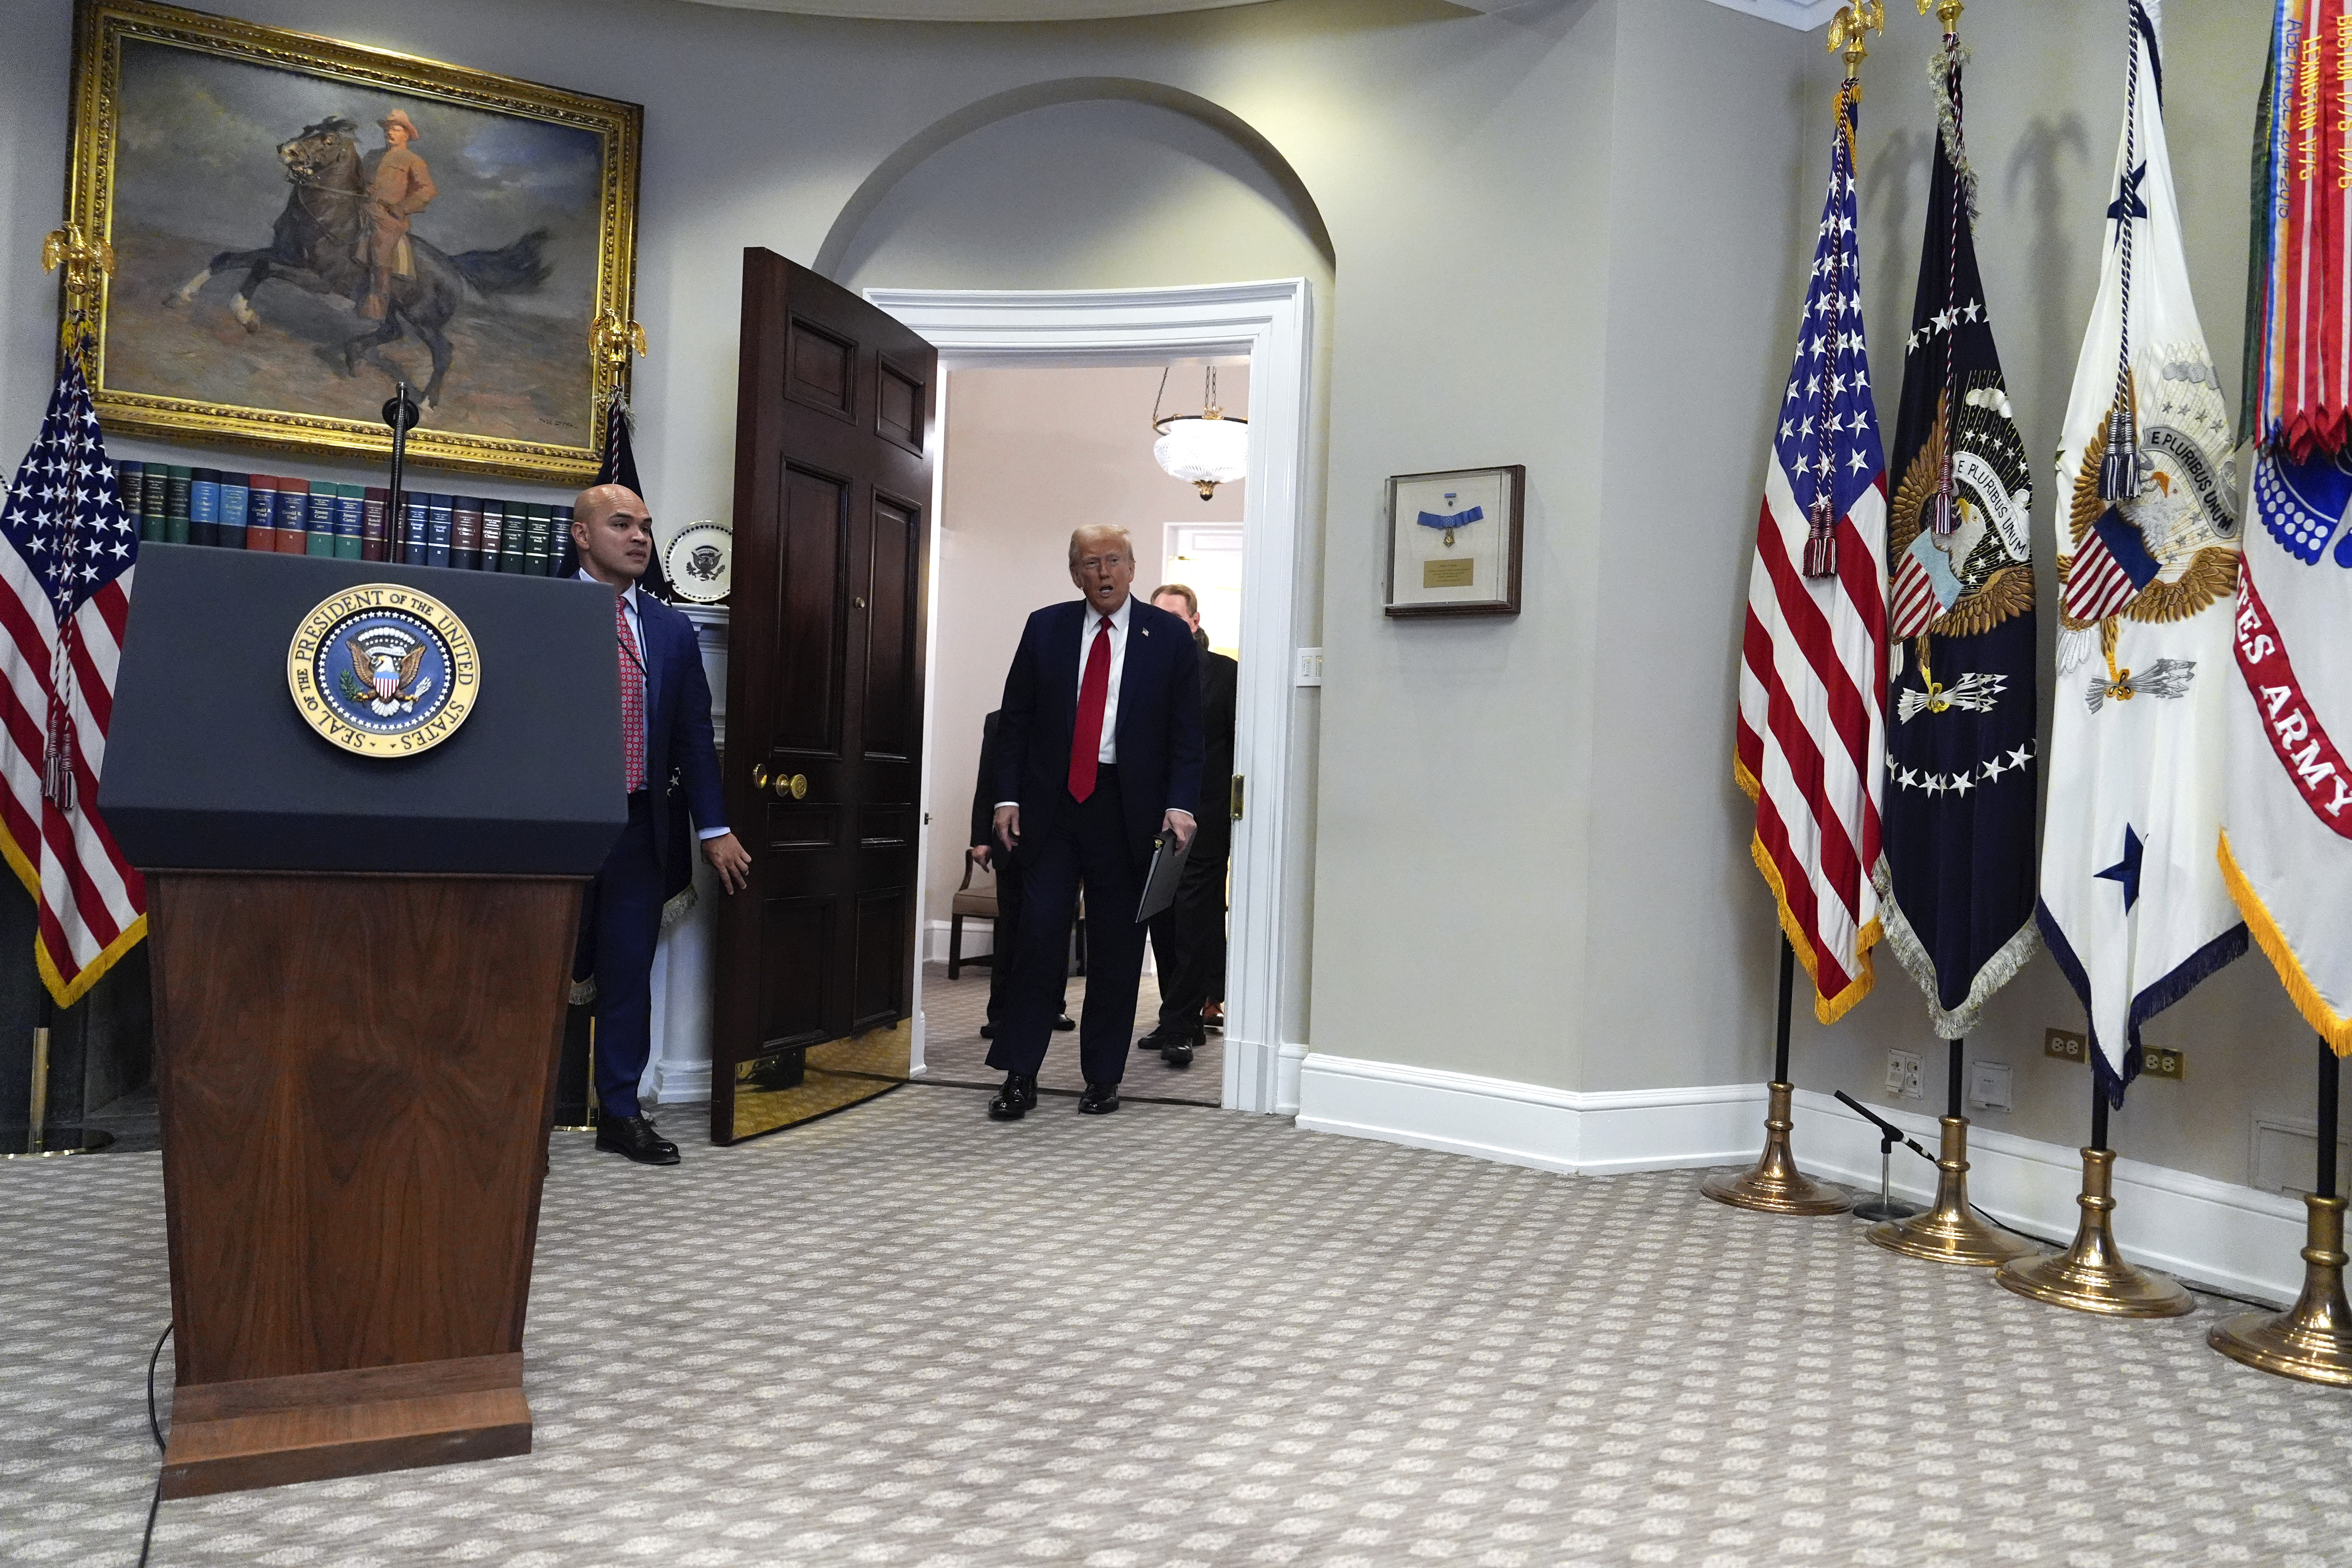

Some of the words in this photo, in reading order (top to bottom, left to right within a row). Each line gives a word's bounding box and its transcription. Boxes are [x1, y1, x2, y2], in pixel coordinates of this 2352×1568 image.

[2298, 35, 2323, 131] LEXINGTON
[1958, 460, 1965, 473] E
[1967, 463, 2008, 518] PLURIBUS
[2002, 517, 2026, 555] UNUM
[2151, 431, 2160, 444] E
[2162, 433, 2212, 491] PLURIBUS
[2204, 490, 2234, 531] UNUM
[295, 591, 383, 662] PRESIDENT
[389, 593, 407, 604] OF
[411, 598, 433, 616] THE
[438, 615, 473, 685] UNITED
[297, 669, 310, 692] THE
[304, 696, 318, 710] OF
[318, 710, 365, 747] SEAL
[401, 700, 465, 749] STATES
[2259, 685, 2352, 817] ARMY
